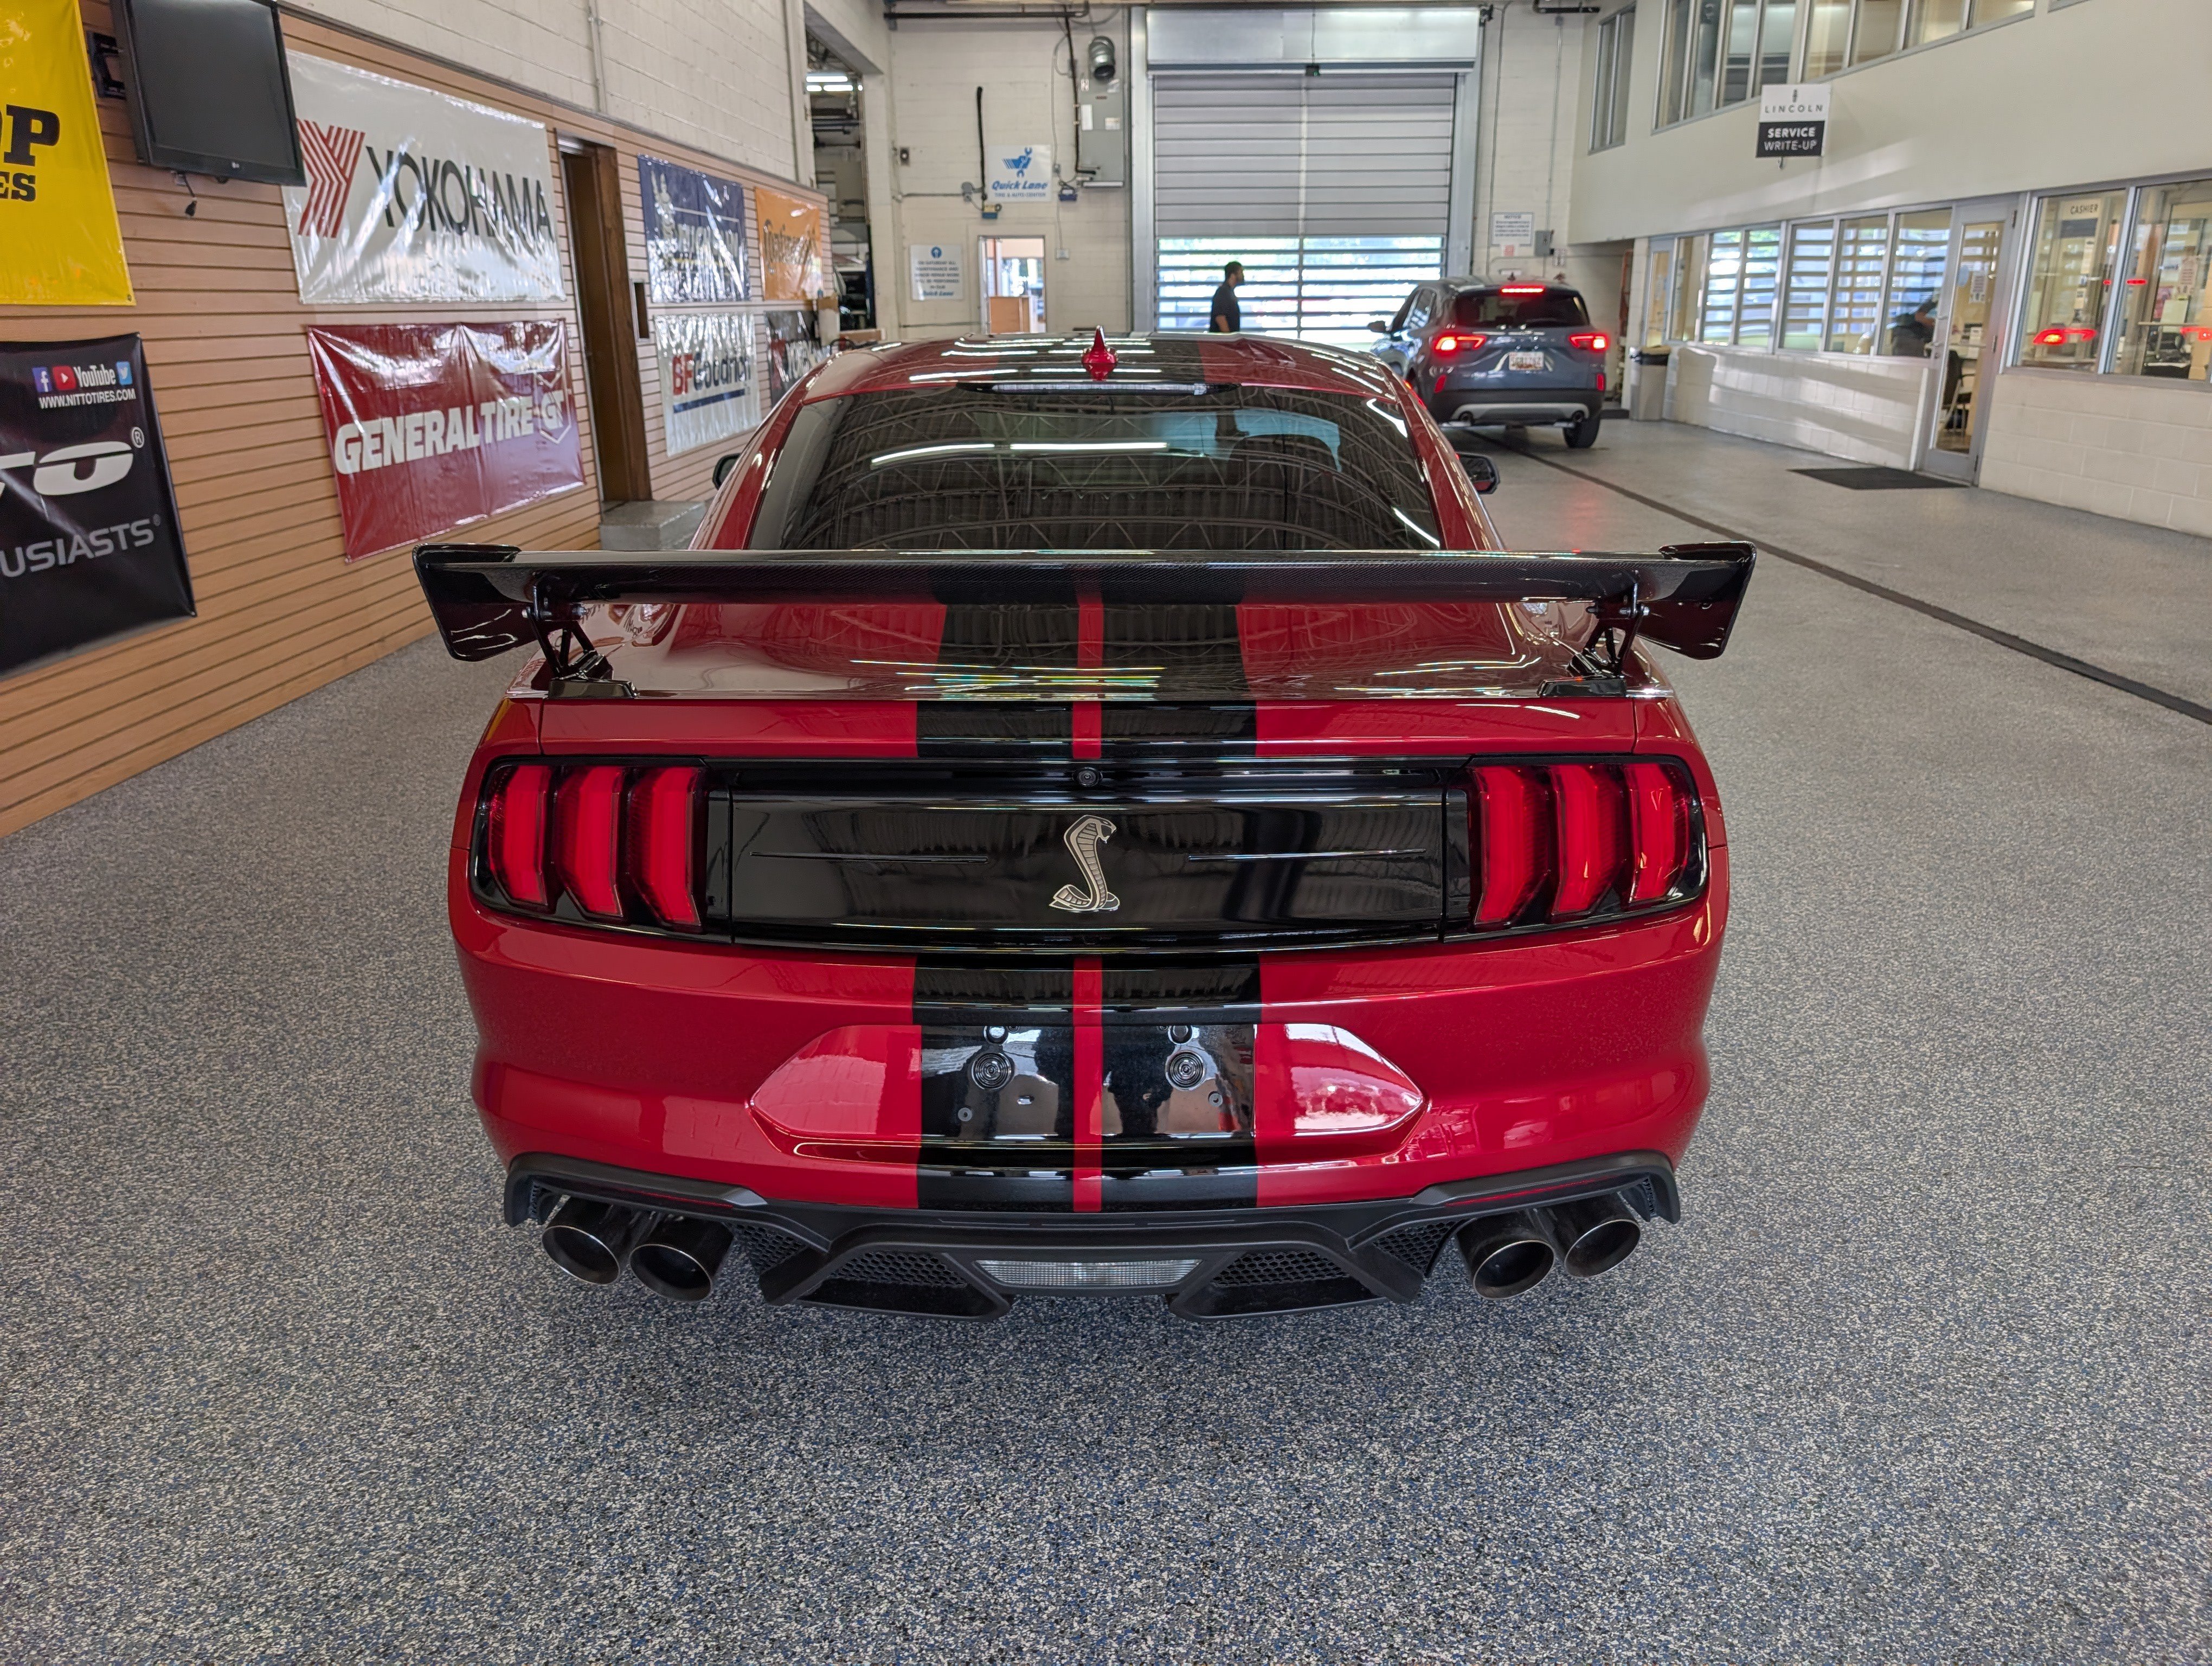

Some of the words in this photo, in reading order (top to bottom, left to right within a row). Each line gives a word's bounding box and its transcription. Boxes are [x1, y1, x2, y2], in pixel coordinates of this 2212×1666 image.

[1765, 104, 1823, 113] LINCOLN
[0, 104, 60, 166] P
[1767, 127, 1816, 138] SERVICE
[1764, 139, 1817, 151] WRITE-UP
[992, 180, 1020, 190] Quick
[1022, 180, 1048, 189] Lane
[366, 146, 555, 243] YOKOHAMA
[2070, 203, 2099, 215] CASHIER
[73, 364, 117, 388] YouTube
[38, 388, 137, 410] WWW.NITTOTIRES.COM
[335, 405, 481, 475] GENERAL
[480, 395, 534, 444] TIRE
